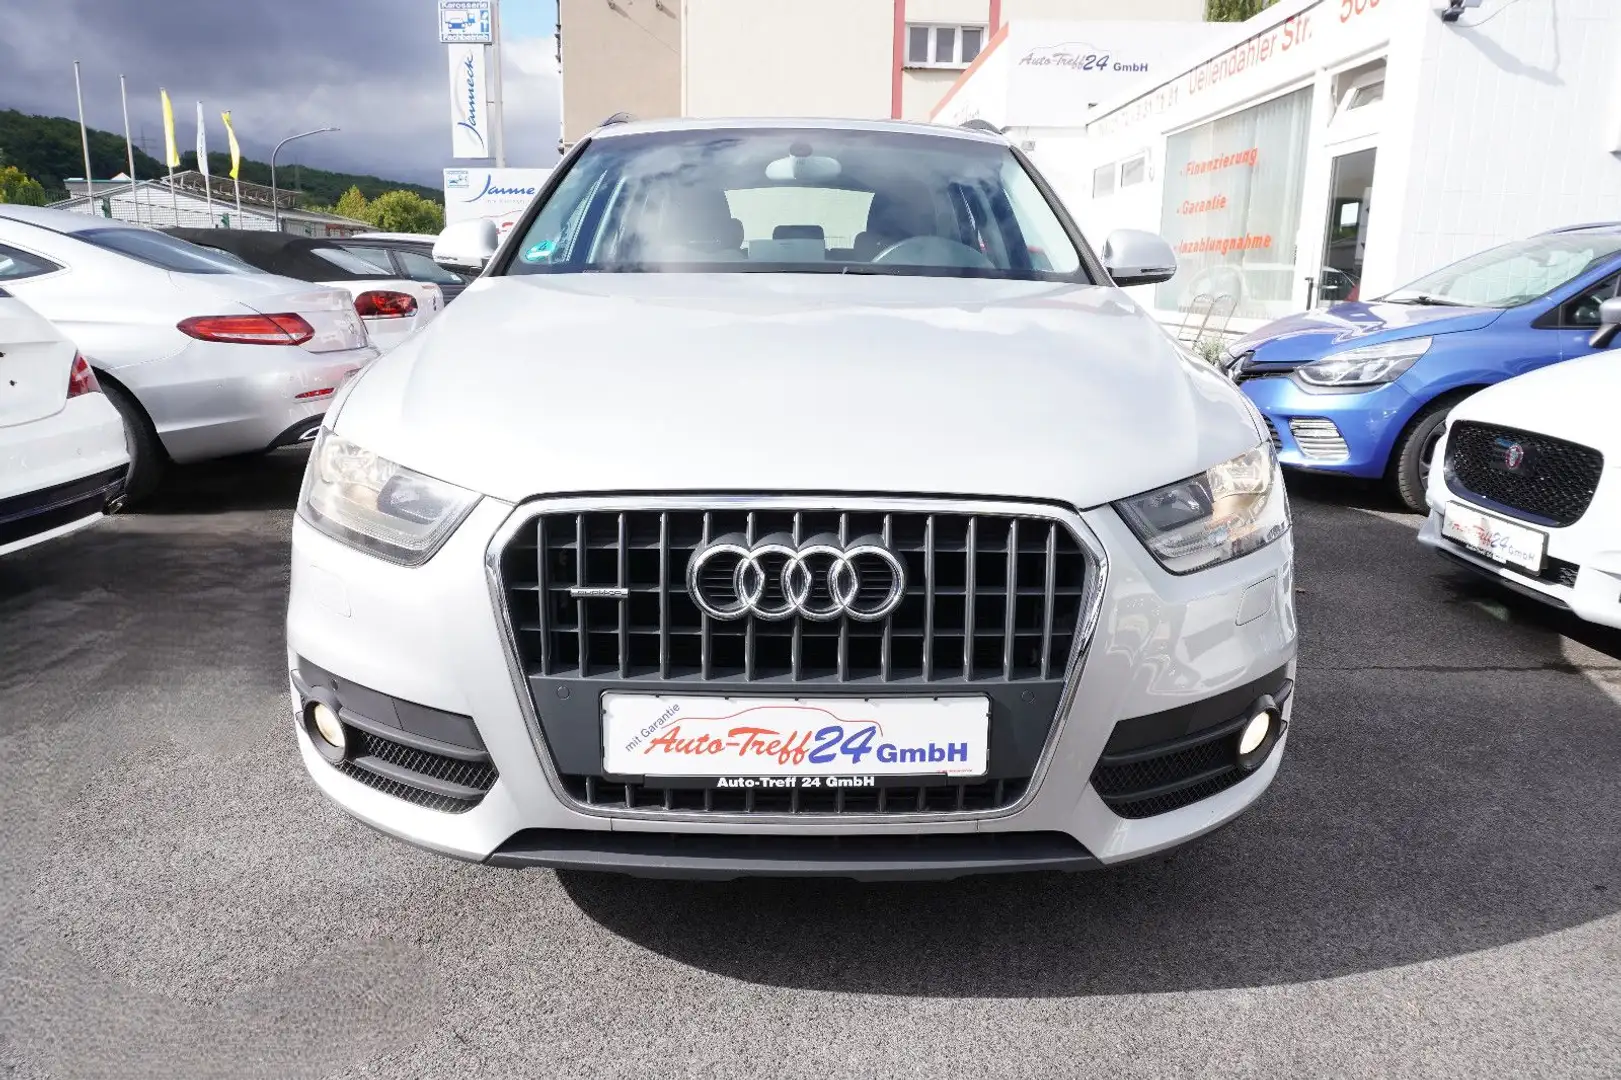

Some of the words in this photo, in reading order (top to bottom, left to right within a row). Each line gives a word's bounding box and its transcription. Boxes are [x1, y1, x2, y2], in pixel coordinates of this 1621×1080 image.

[1189, 33, 1278, 95] Uellendahler
[1281, 15, 1313, 51] Str.
[1113, 62, 1149, 72] GmbH
[1186, 147, 1258, 175] Finanzierung
[1182, 195, 1227, 215] Garantie
[1179, 233, 1272, 256] Inzahlungnahme
[625, 738, 642, 753] mit
[640, 702, 681, 739] Garantie
[876, 742, 968, 763] GmbH
[716, 777, 797, 788] Auto-Treff
[801, 776, 822, 788] 24
[825, 775, 875, 787] GmbH
